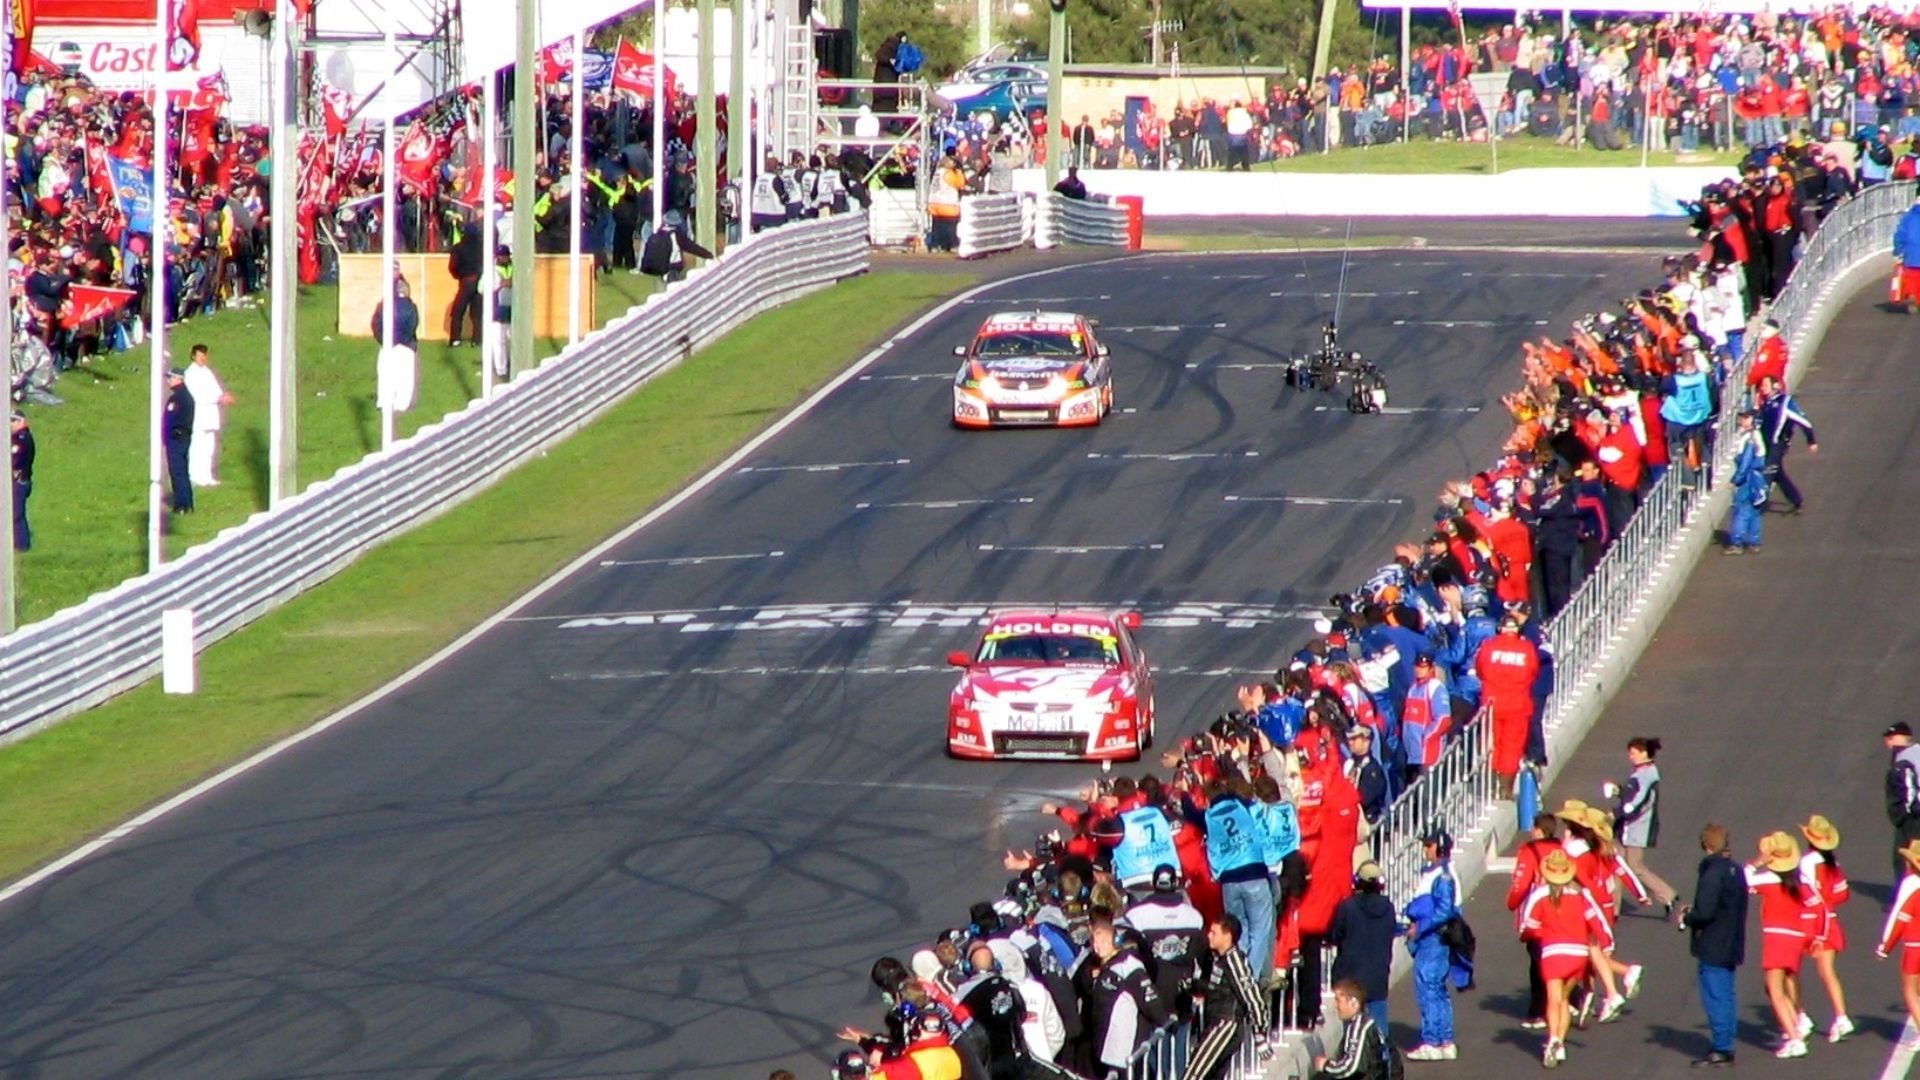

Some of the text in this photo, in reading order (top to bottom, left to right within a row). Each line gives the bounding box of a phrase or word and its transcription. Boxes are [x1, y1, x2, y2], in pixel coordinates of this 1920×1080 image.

[987, 322, 1077, 332] HOLDEN
[993, 623, 1110, 636] HOLDEN
[1491, 650, 1526, 666] FIRE
[1143, 823, 1155, 842] 7
[1223, 817, 1239, 837] 2
